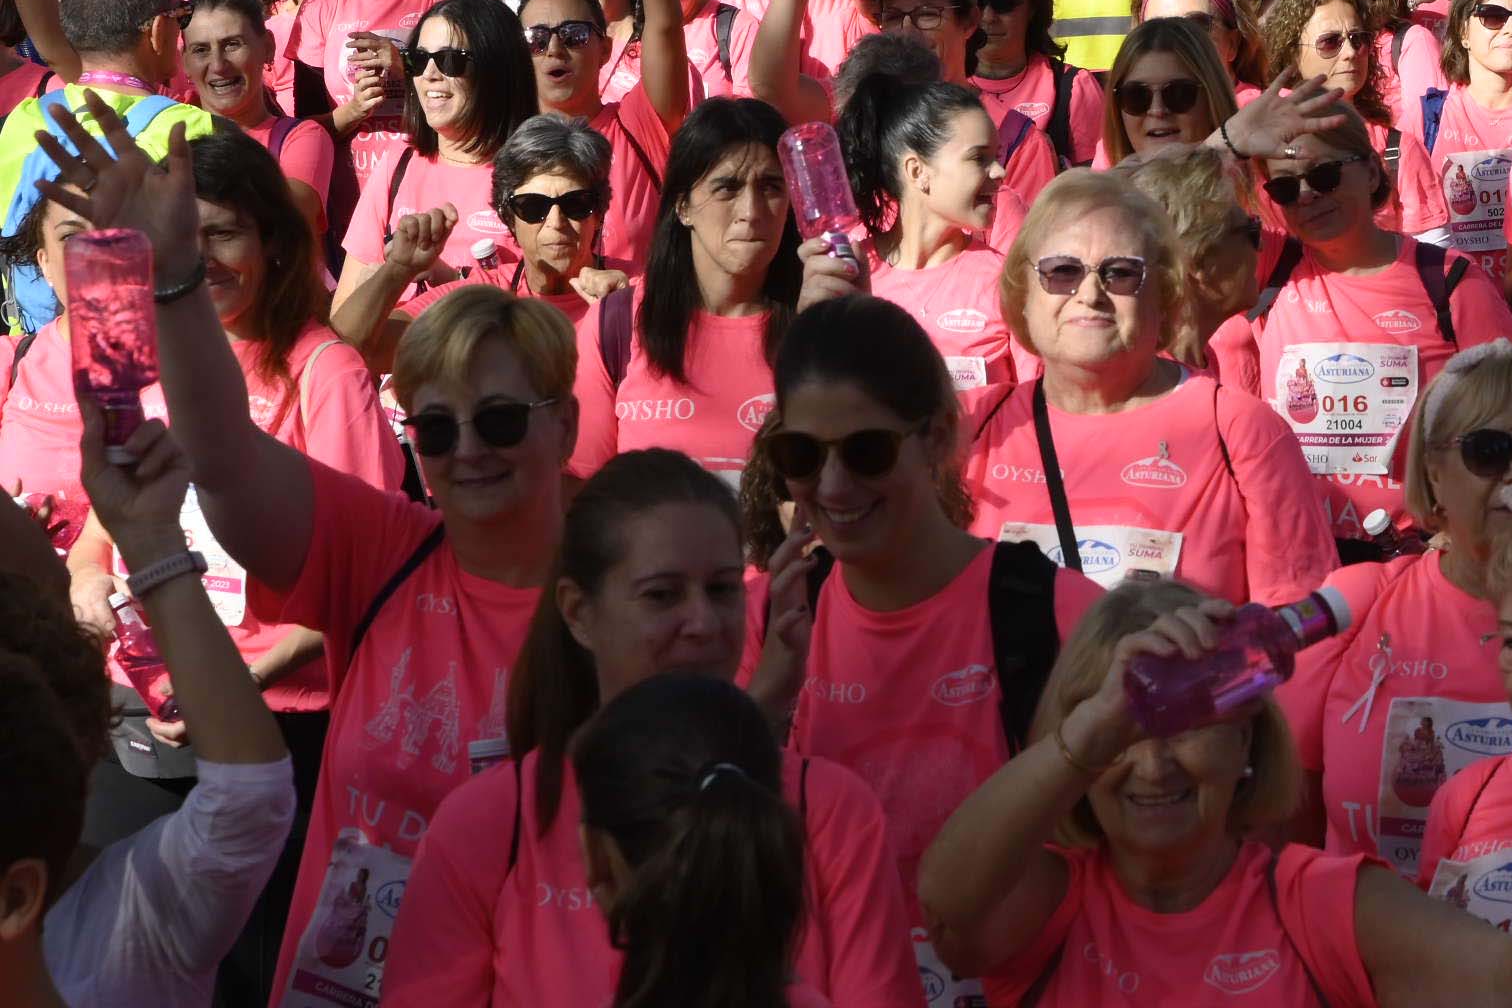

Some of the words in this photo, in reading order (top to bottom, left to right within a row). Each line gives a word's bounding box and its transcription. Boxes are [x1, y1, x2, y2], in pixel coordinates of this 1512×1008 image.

[1479, 190, 1506, 204] 01
[1318, 364, 1370, 377] ASTURIANA
[1322, 395, 1369, 413] 016
[1326, 419, 1363, 431] 21004
[344, 785, 387, 827] TU
[399, 810, 428, 842] D
